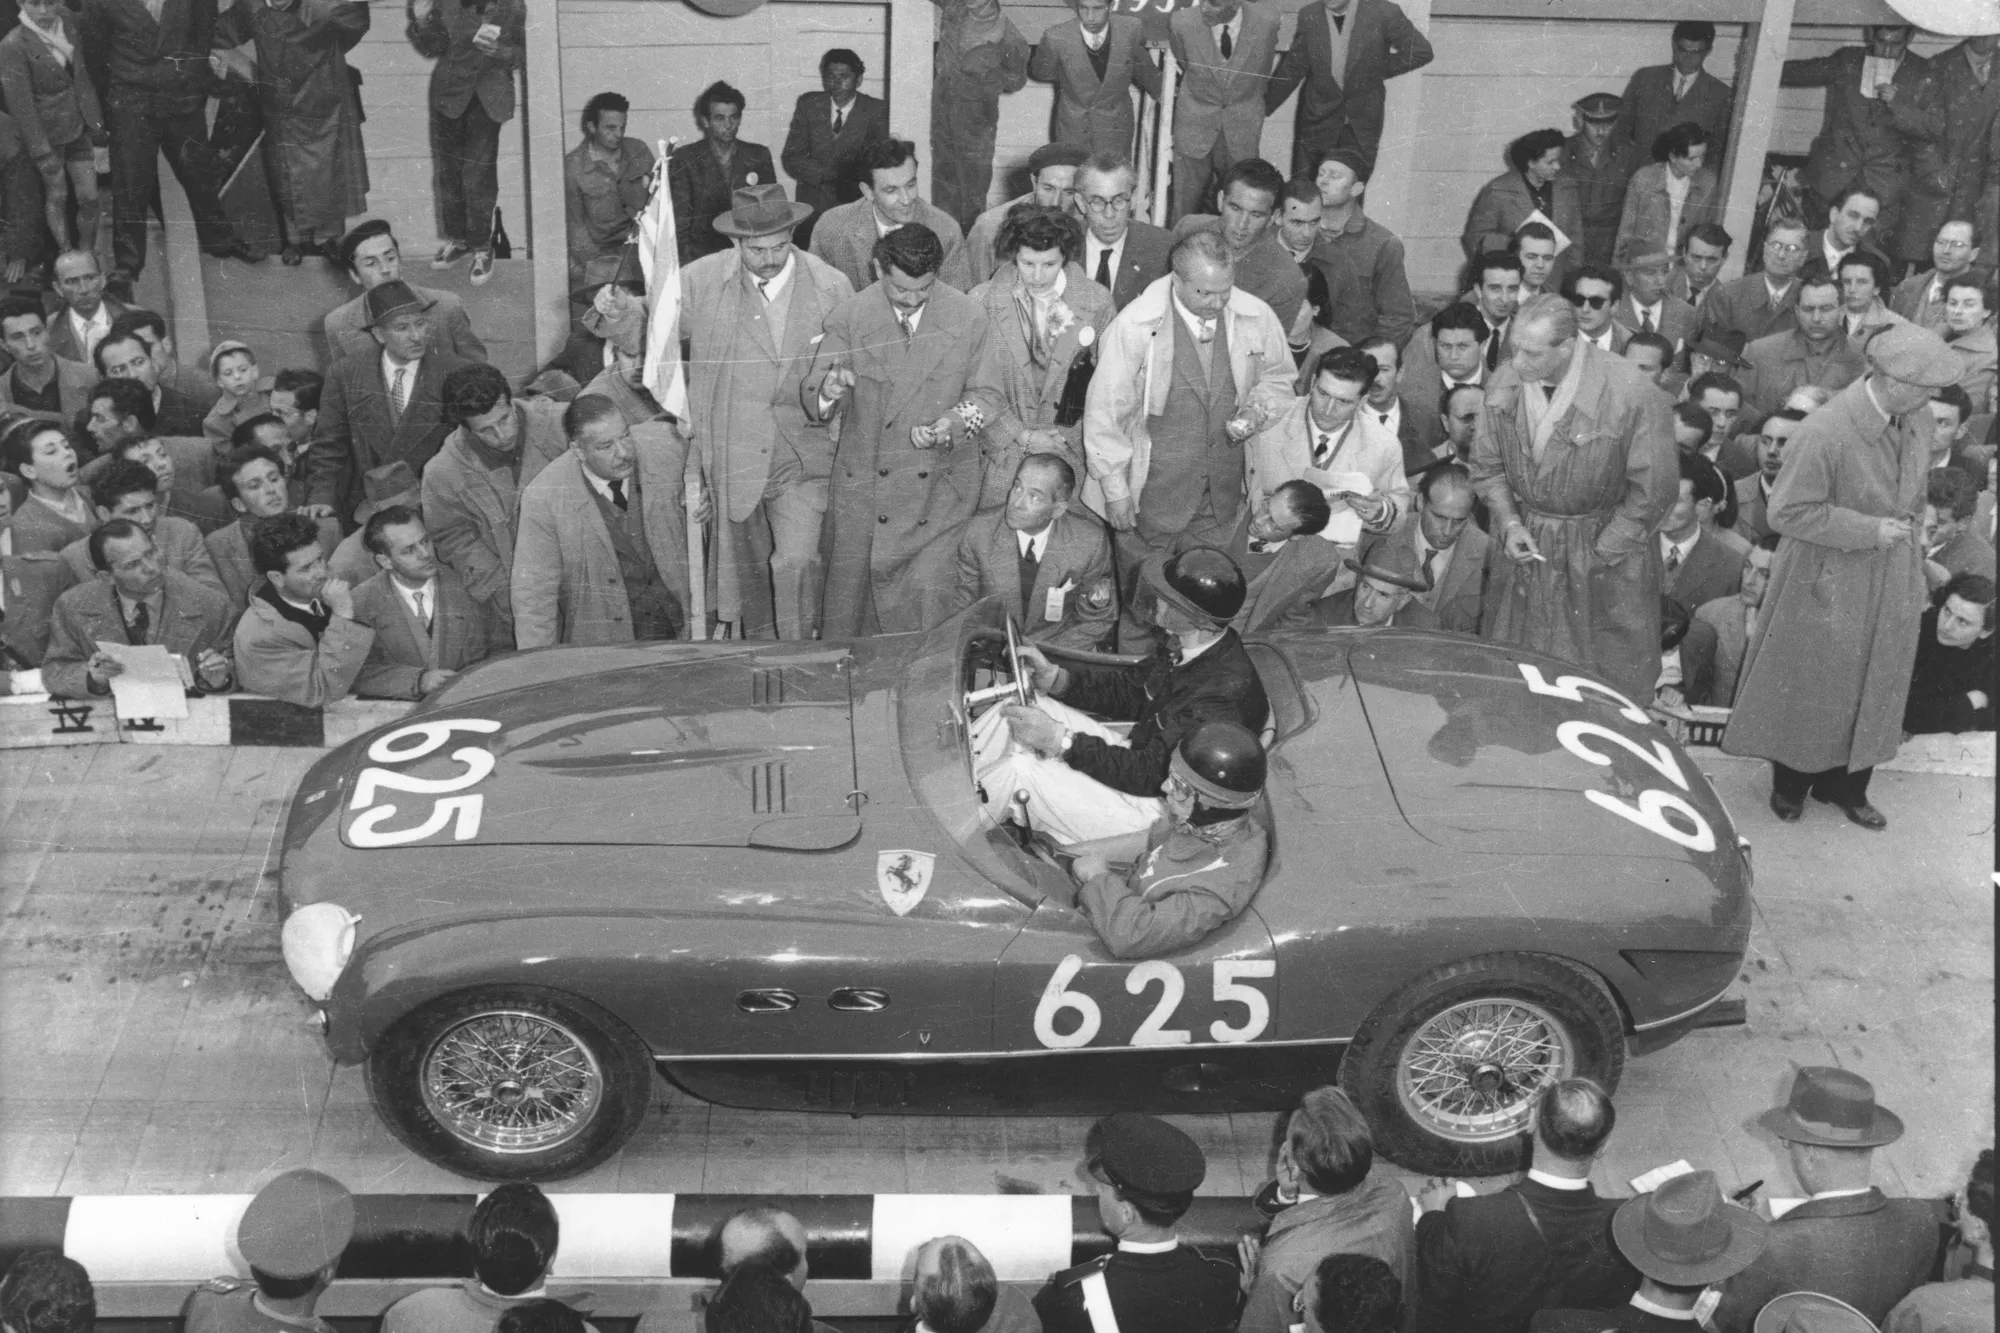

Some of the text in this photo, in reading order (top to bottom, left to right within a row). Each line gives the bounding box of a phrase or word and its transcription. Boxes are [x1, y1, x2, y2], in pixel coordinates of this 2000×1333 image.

[348, 718, 503, 848] 625
[1518, 663, 1717, 853] 625
[1033, 953, 1276, 1049] 625
